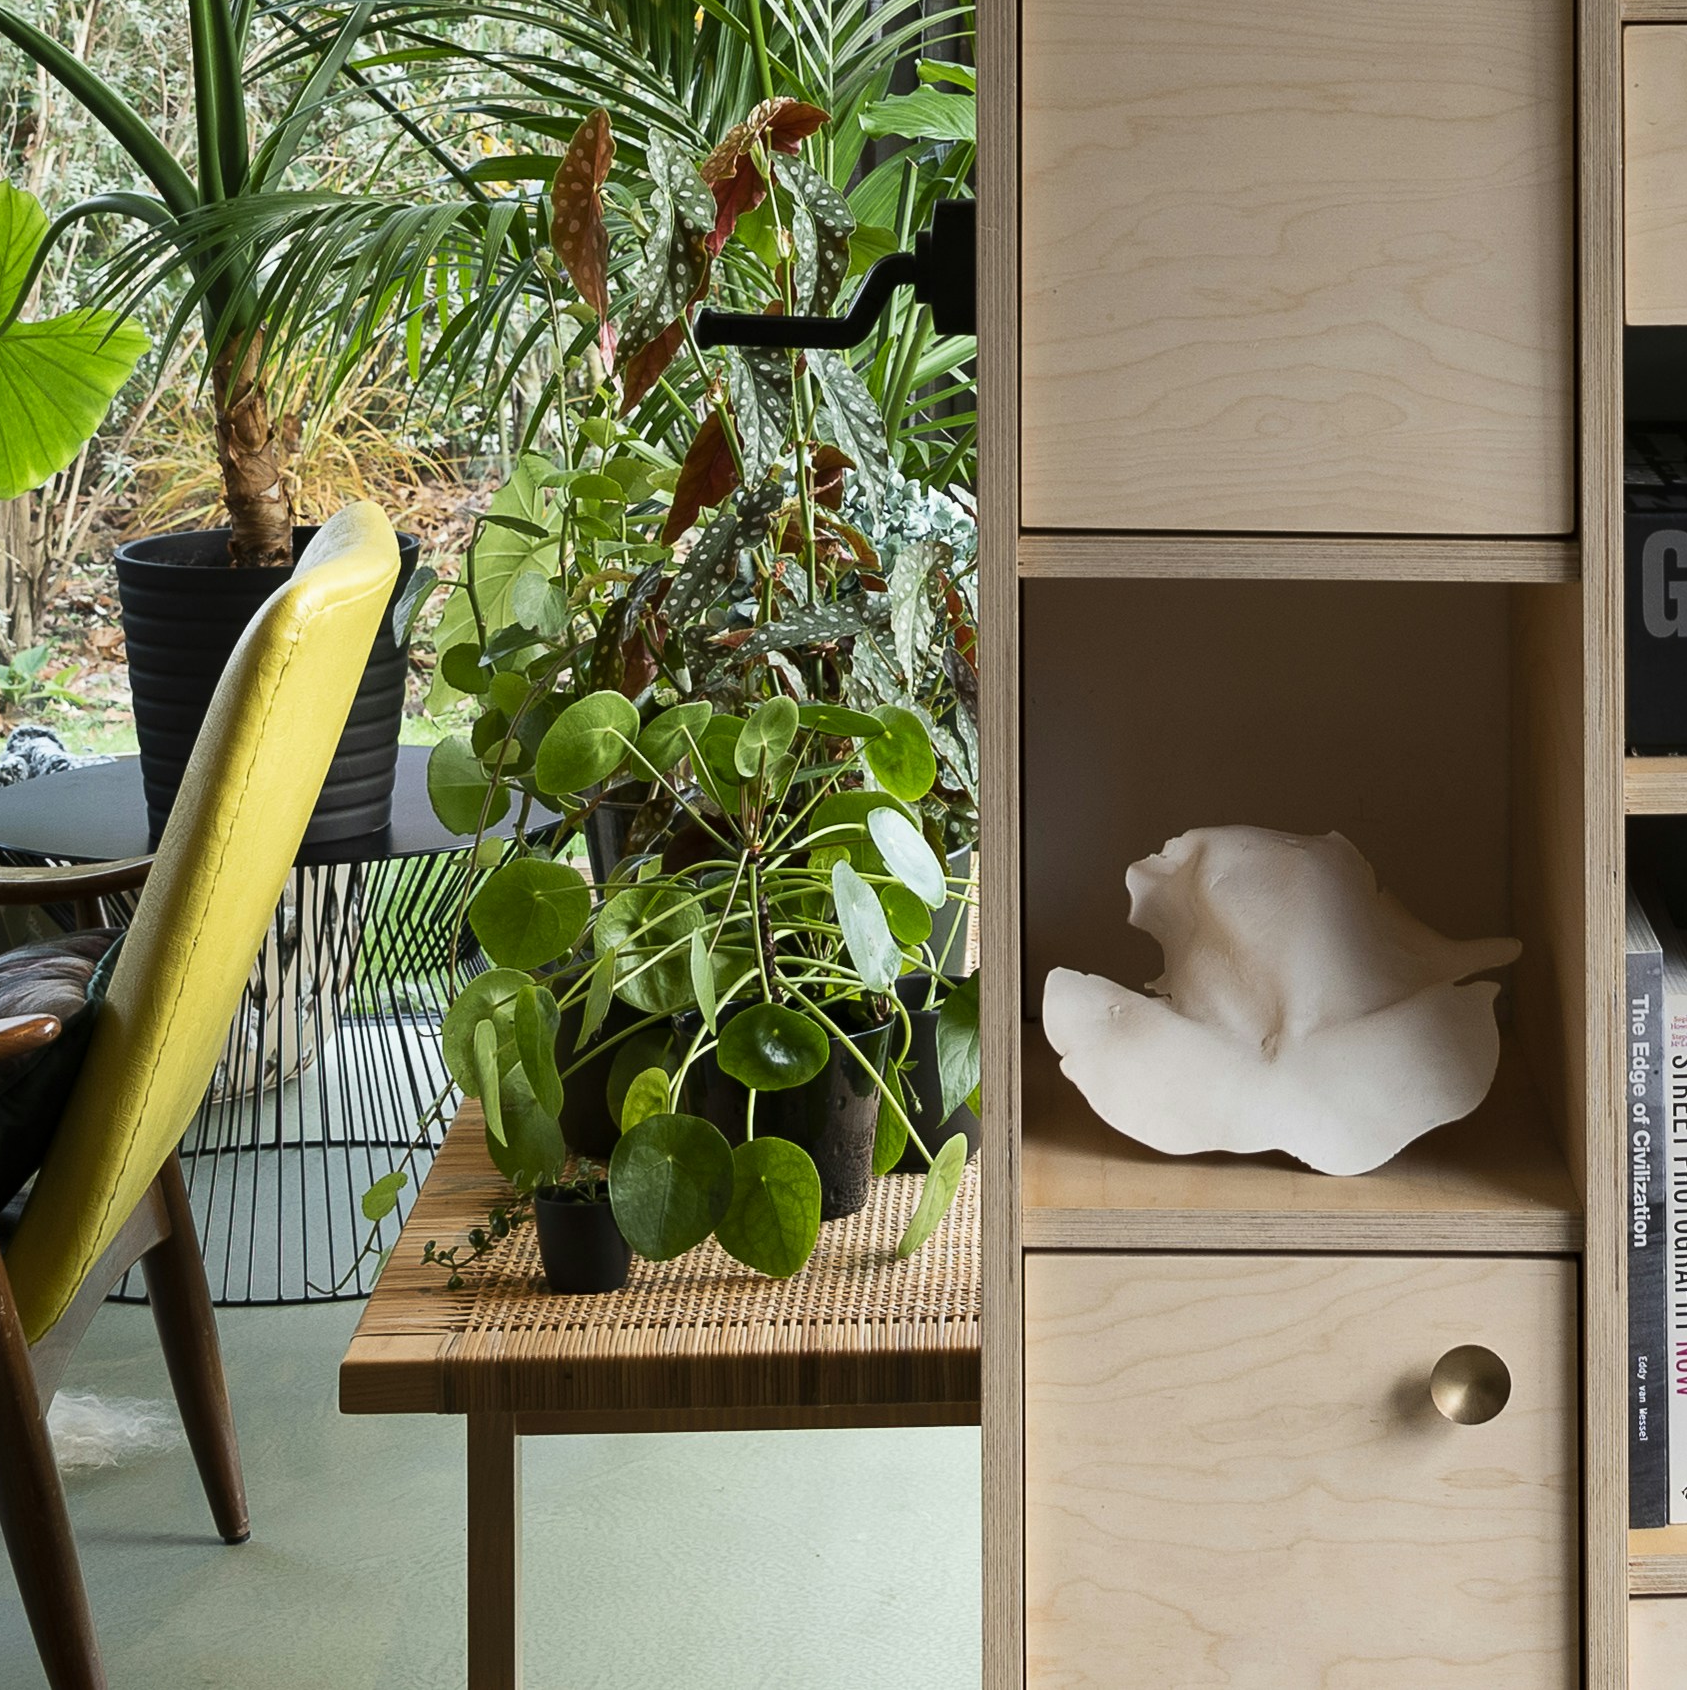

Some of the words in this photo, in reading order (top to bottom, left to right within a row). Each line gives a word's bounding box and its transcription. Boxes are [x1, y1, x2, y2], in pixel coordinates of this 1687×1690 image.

[1631, 993, 1650, 1036] The
[1629, 1042, 1651, 1098] Edge
[1632, 1105, 1649, 1127] of
[1632, 1128, 1652, 1248] Civilization
[1636, 1355, 1649, 1380] Eddy
[1637, 1385, 1648, 1403] van
[1637, 1407, 1648, 1442] Wessel
